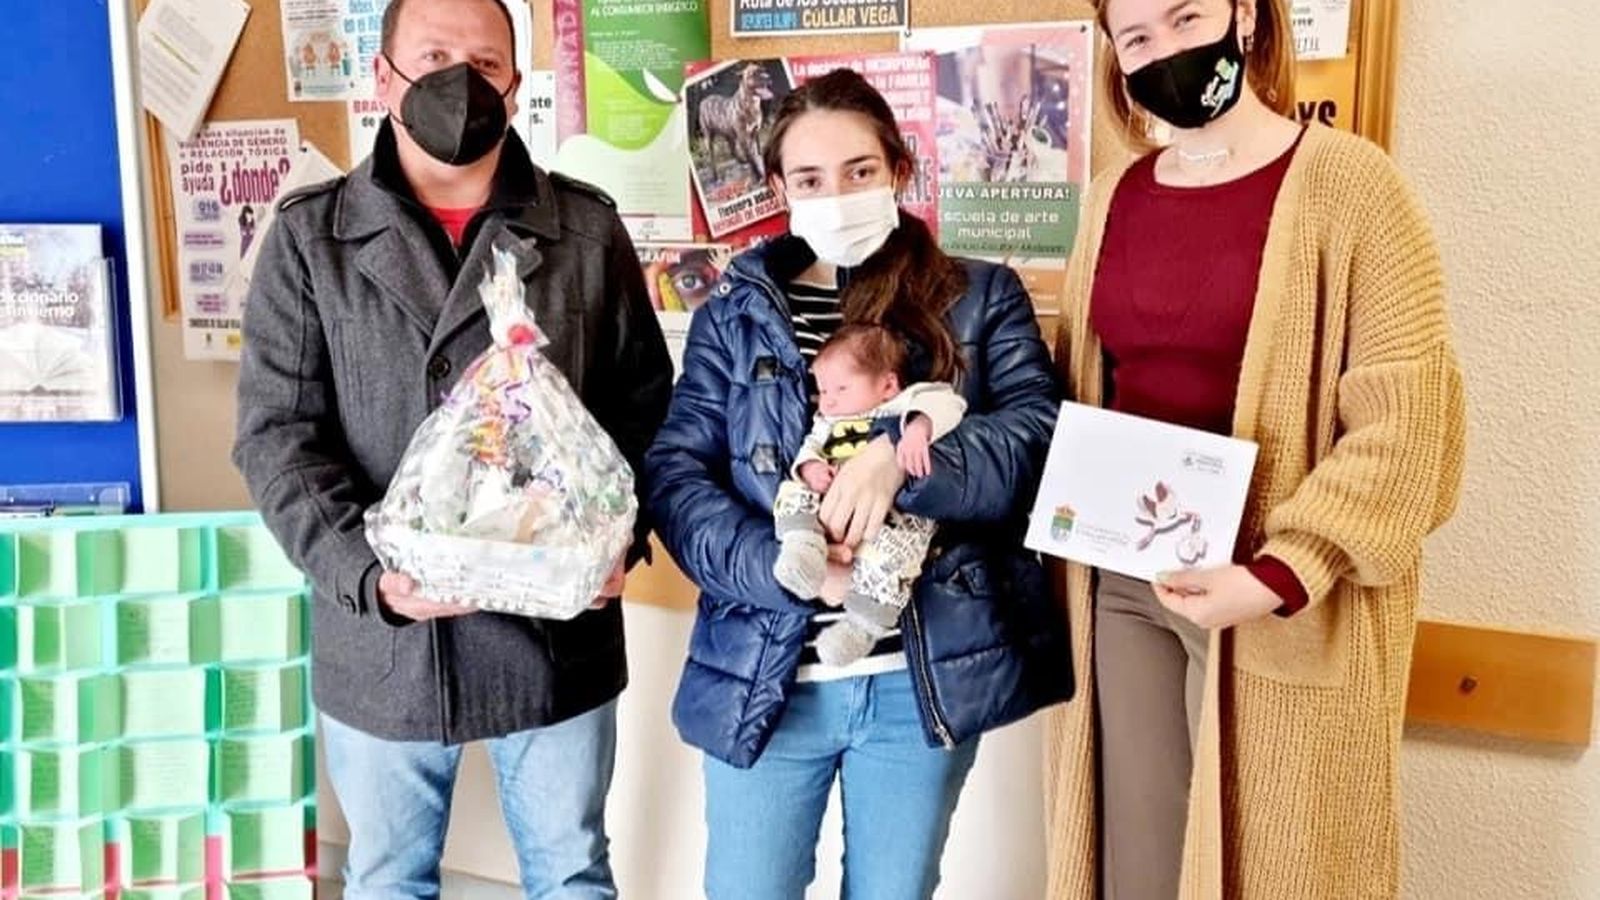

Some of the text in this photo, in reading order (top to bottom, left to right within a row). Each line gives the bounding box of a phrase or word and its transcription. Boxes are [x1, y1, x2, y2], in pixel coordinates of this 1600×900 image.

[858, 6, 899, 26] VEGA
[181, 161, 213, 175] pide
[182, 177, 215, 196] ayuda
[981, 186, 1070, 200] APERTURA!
[1000, 210, 1020, 223] de
[1024, 211, 1060, 223] arte
[957, 226, 1032, 240] municipal
